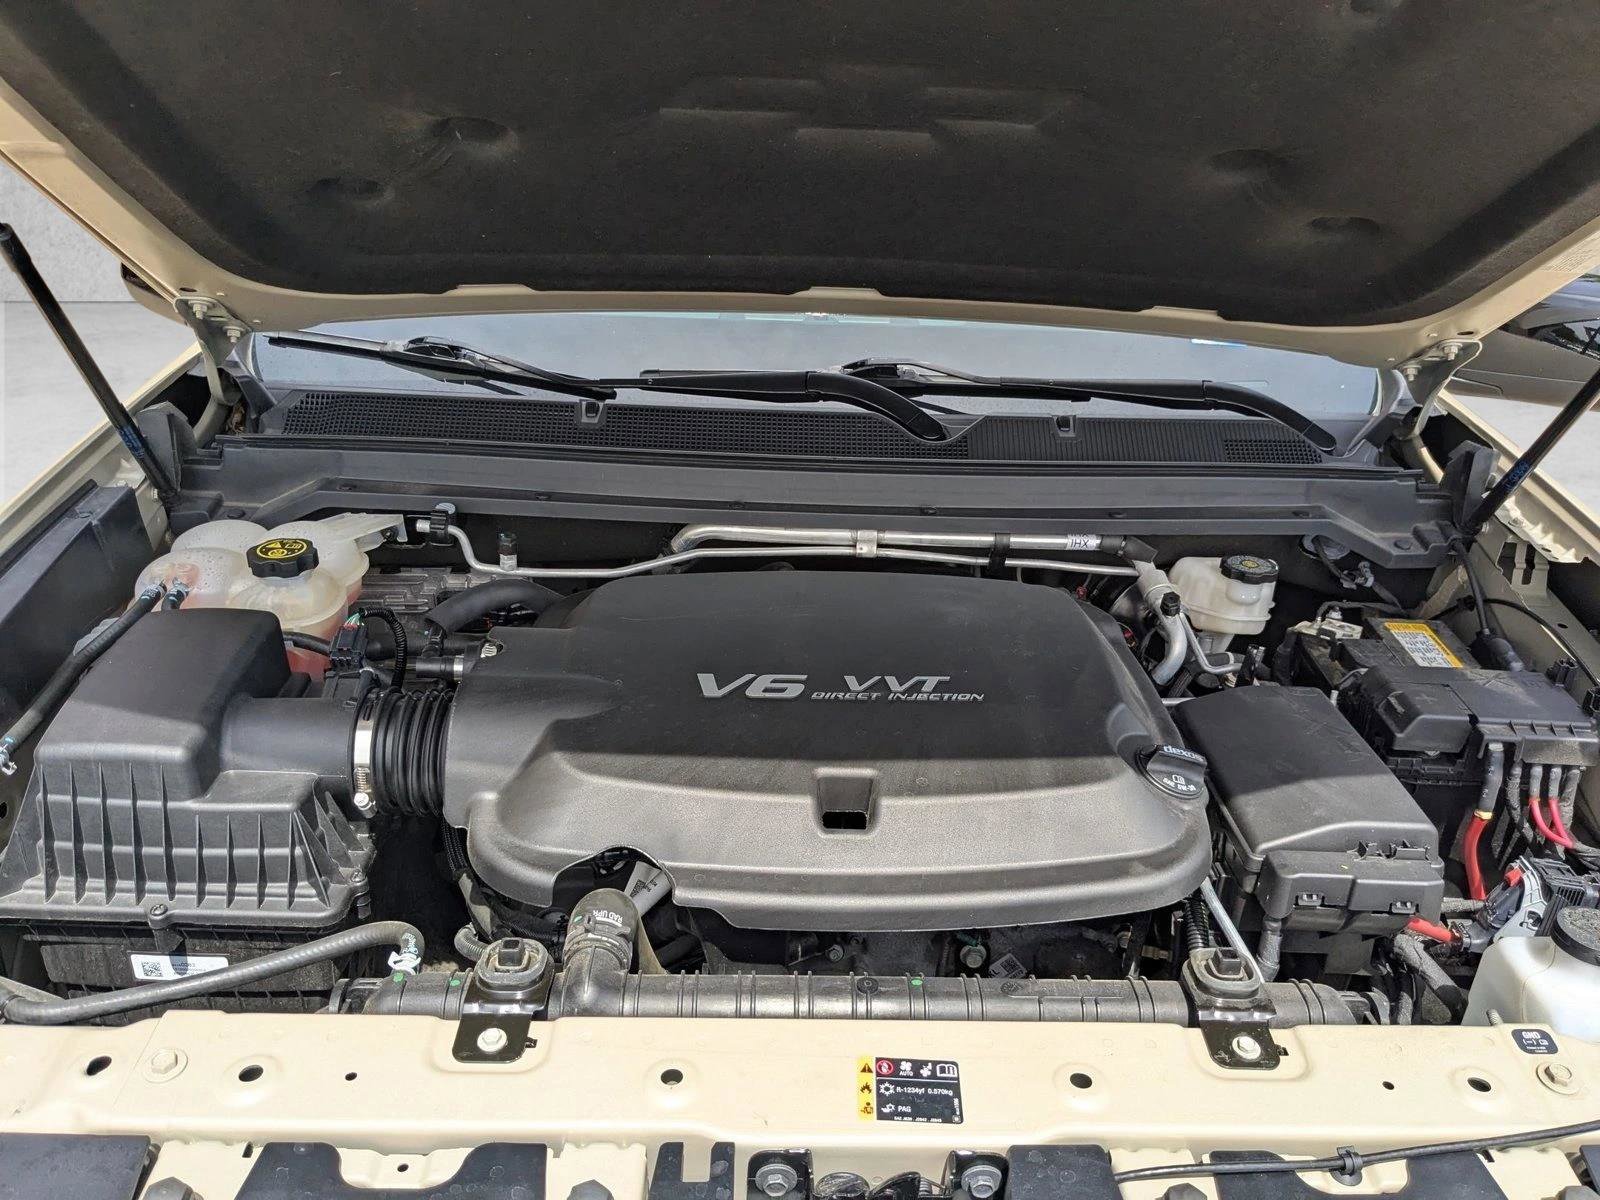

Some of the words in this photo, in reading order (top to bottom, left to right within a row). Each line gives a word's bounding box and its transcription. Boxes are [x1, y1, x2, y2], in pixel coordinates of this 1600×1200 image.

[697, 673, 808, 699] V6
[843, 675, 951, 693] VVT
[811, 691, 881, 700] DIRECT
[887, 692, 984, 702] INJECTION
[593, 909, 608, 918] UPR
[609, 911, 623, 924] RAD
[1522, 1031, 1541, 1039] GND
[896, 1086, 925, 1095] R-1234yf
[897, 1105, 912, 1113] PAG
